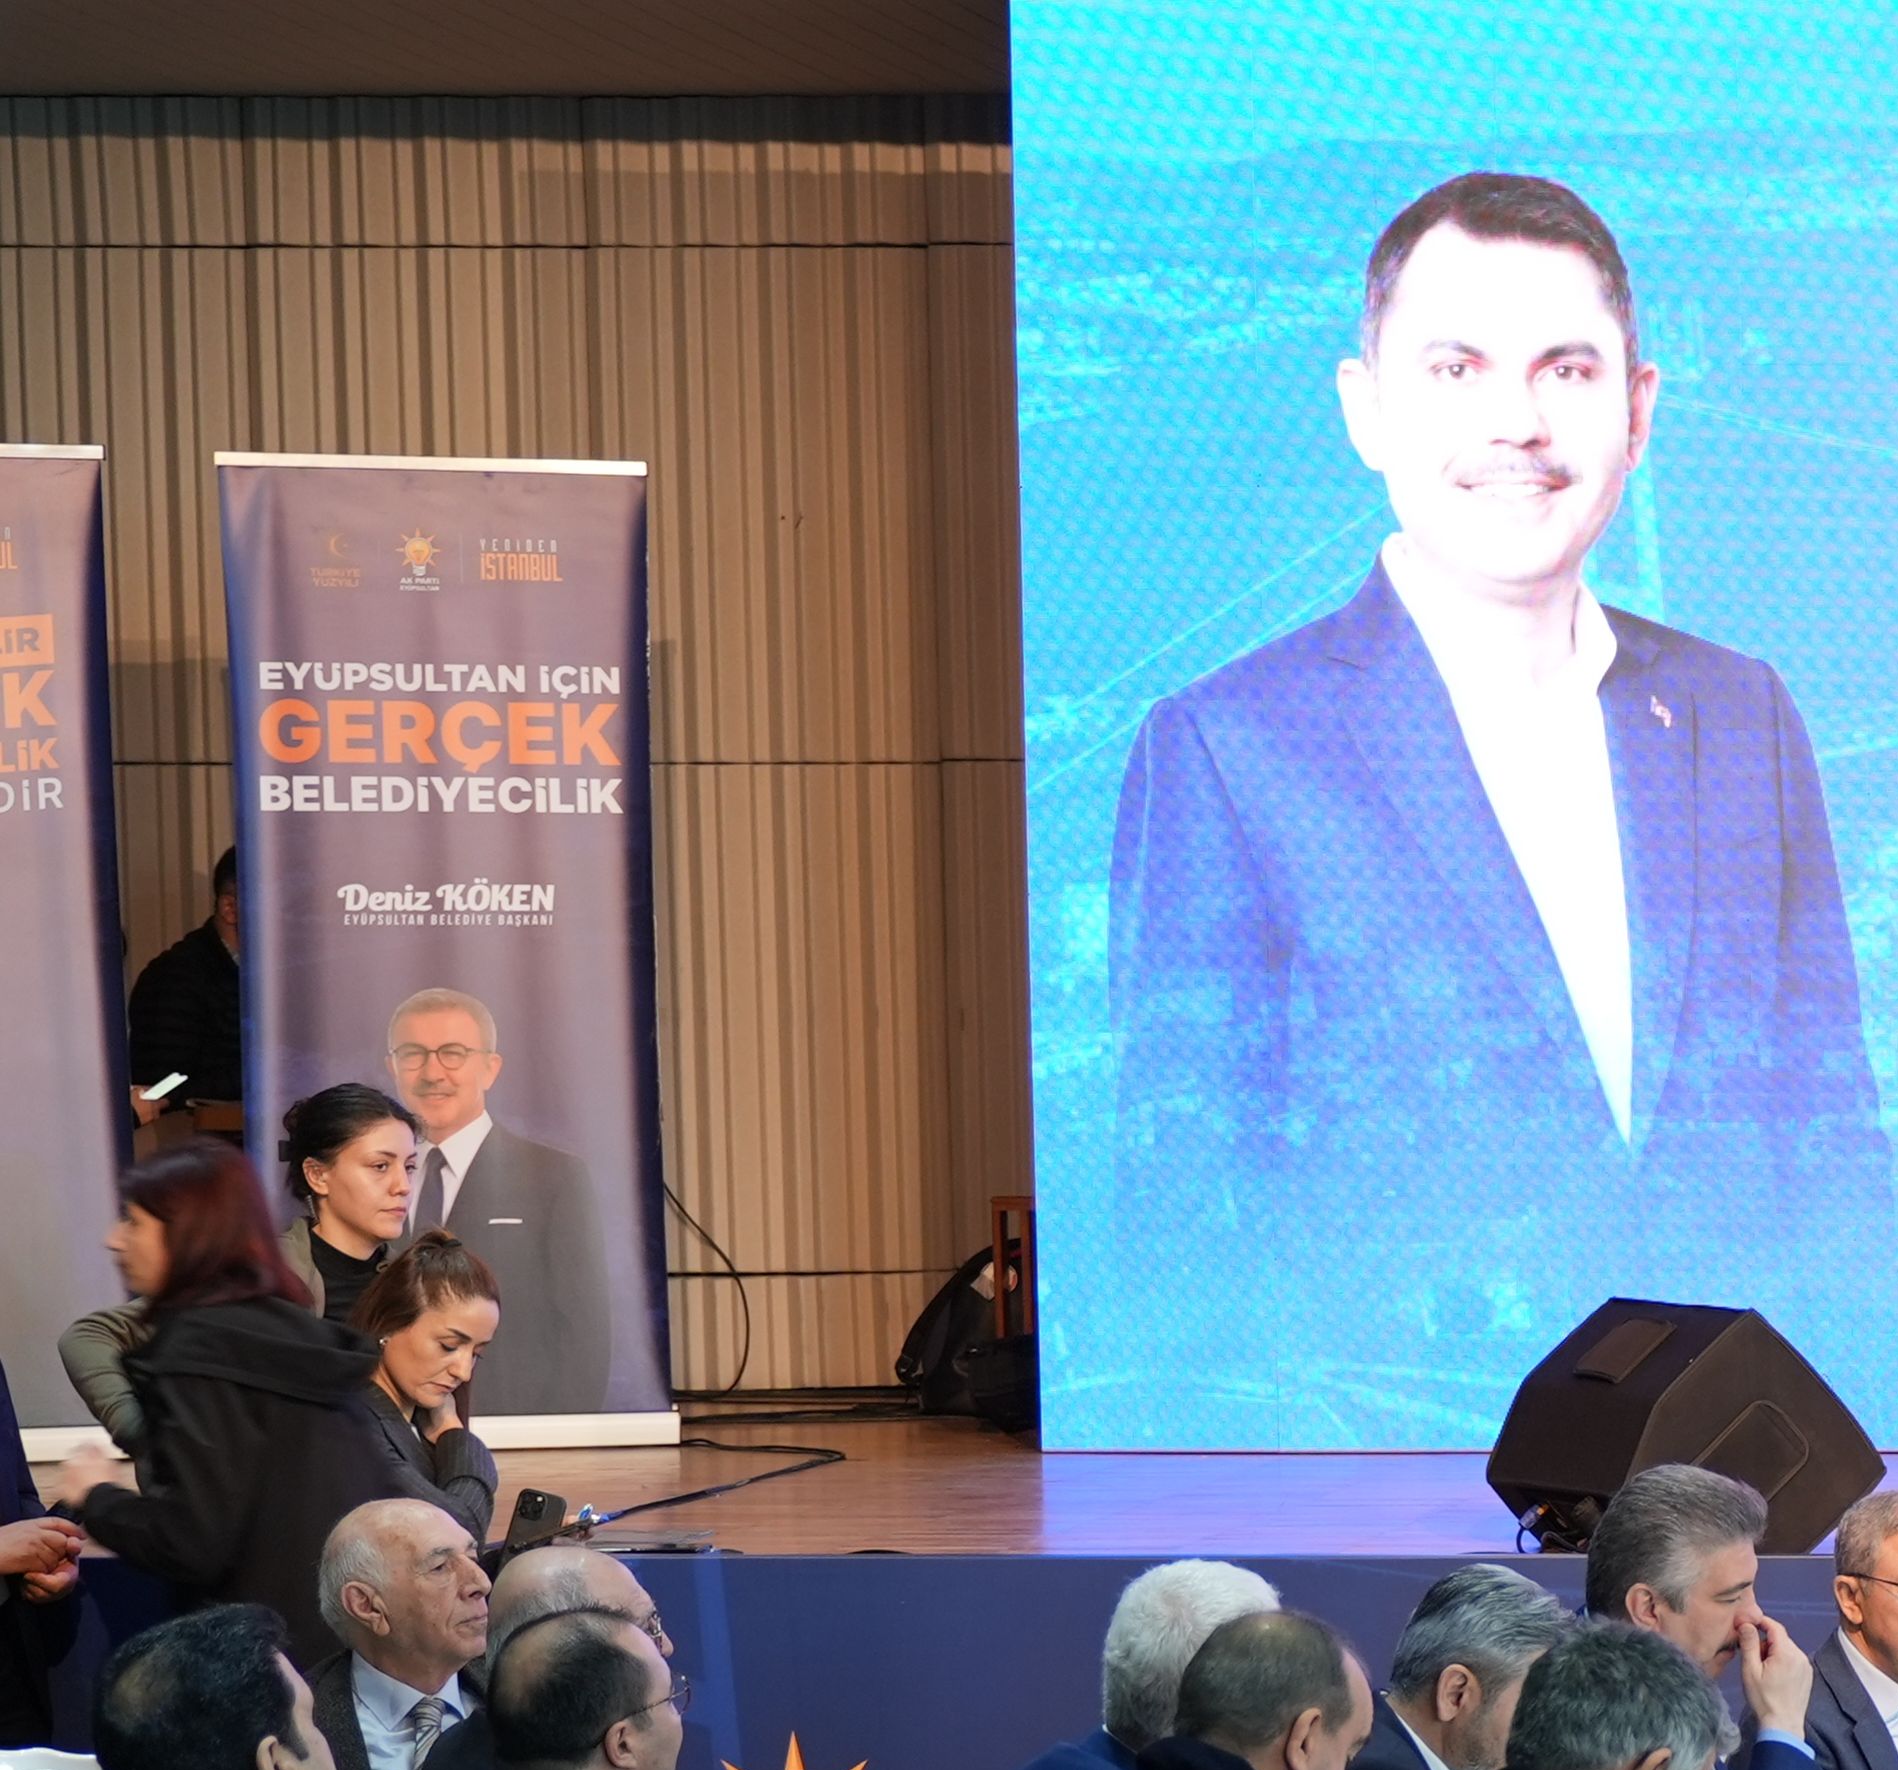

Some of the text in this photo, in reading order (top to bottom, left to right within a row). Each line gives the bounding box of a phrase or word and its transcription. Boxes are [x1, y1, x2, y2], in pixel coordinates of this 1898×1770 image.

[259, 662, 526, 692] EYÜPSULTAN
[259, 698, 622, 774] GERÇEK
[337, 877, 555, 911] Deniz KÖKEN
[344, 914, 424, 926] EYÜPSULTAN
